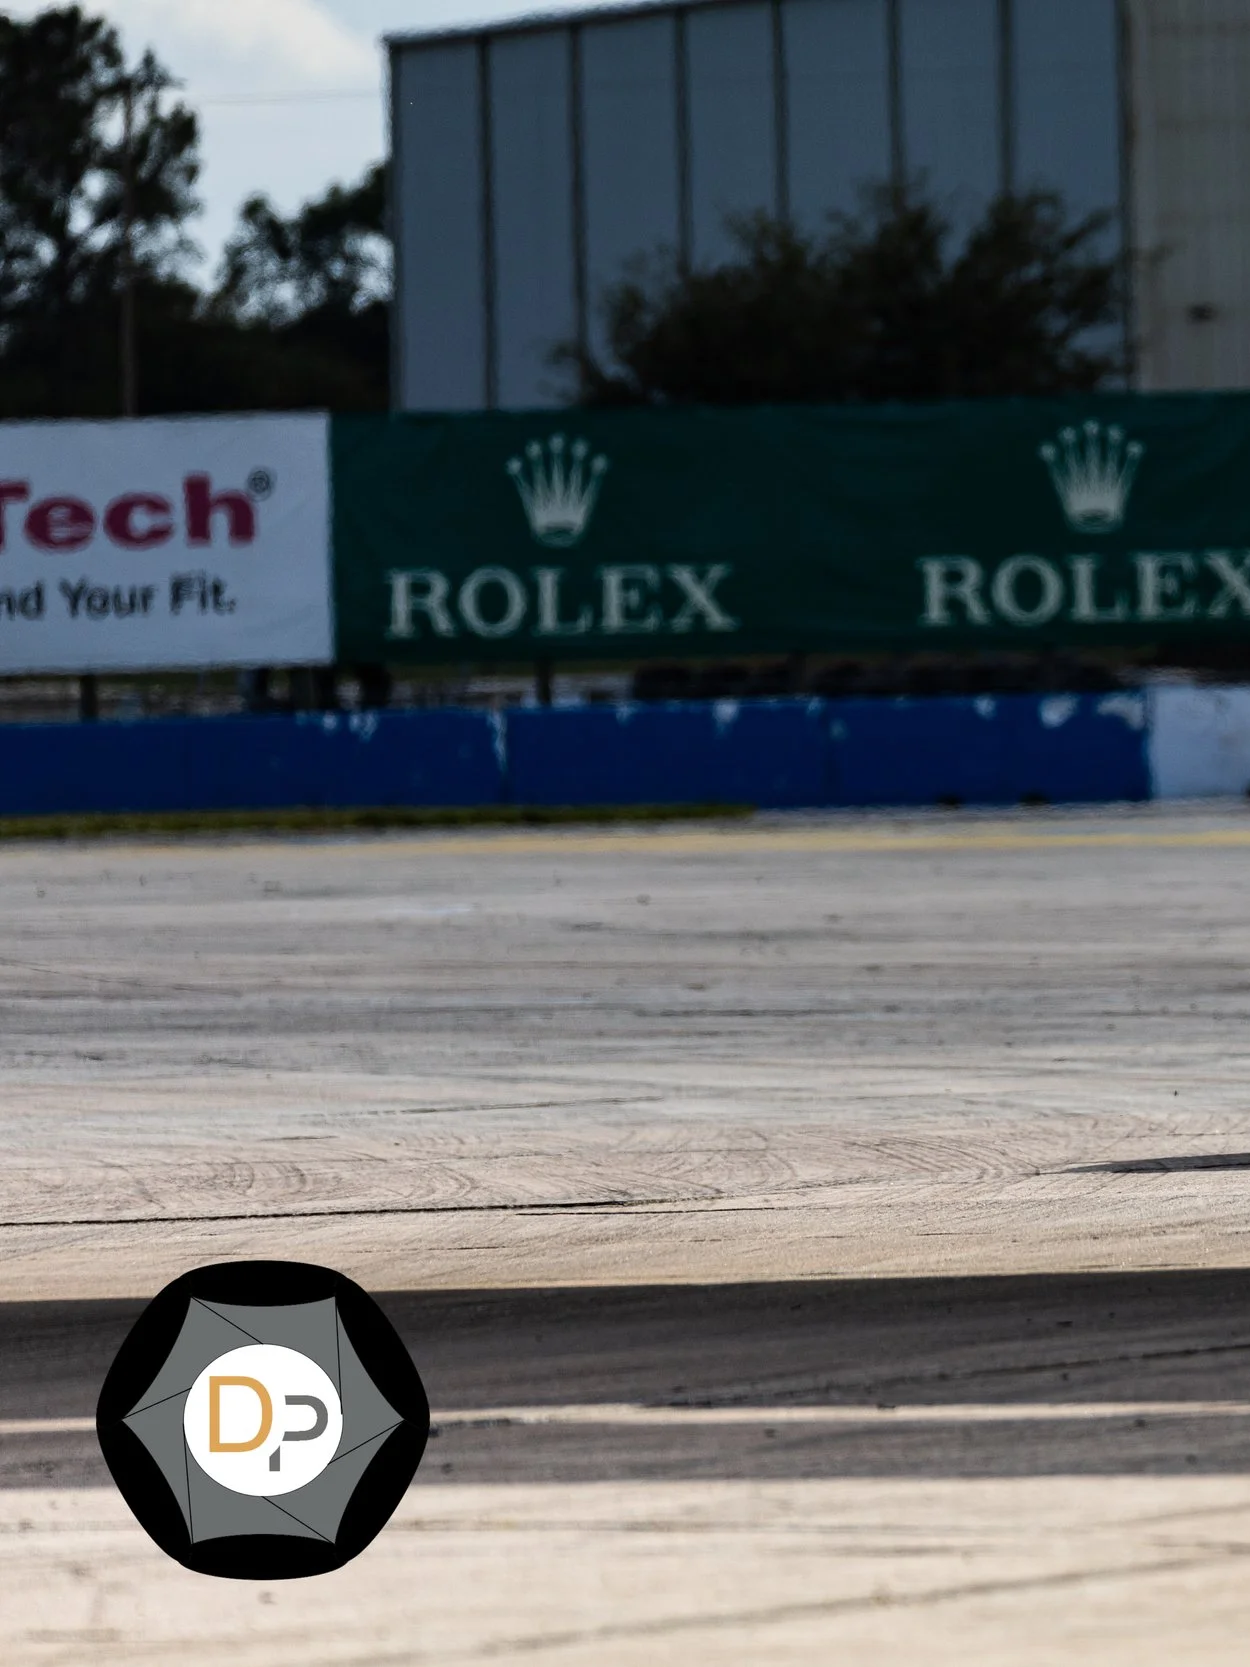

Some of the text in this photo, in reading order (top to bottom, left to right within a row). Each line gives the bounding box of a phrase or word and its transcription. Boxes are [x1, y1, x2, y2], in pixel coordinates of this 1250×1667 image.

[59, 575, 156, 619] Your
[169, 569, 236, 616] Fit.
[386, 564, 738, 637] ROLEX
